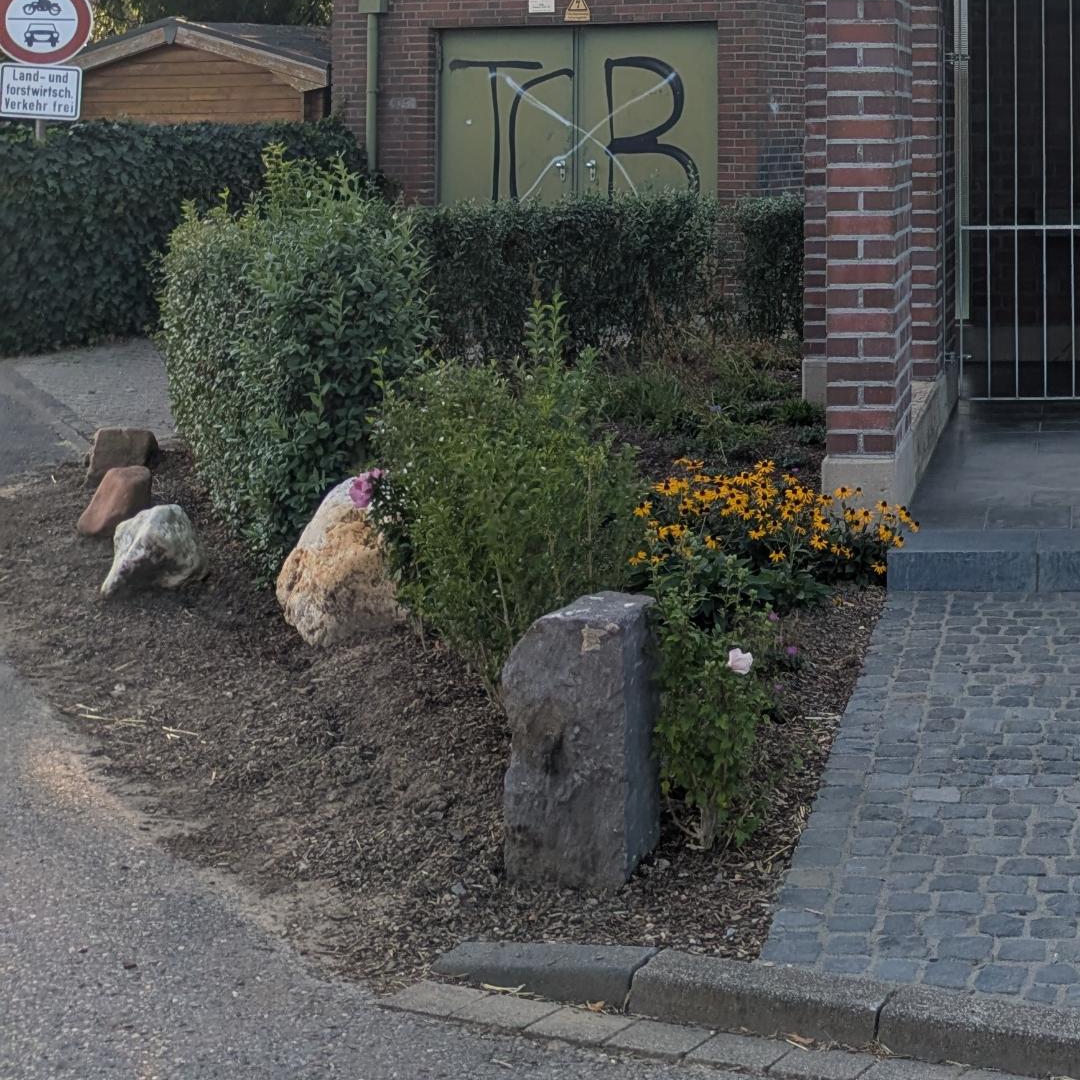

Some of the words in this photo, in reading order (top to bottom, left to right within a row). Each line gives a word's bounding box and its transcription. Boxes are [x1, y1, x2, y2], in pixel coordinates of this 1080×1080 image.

[12, 69, 46, 82] Land-
[48, 72, 69, 84] und
[6, 84, 74, 99] forstwirtsch.
[4, 98, 48, 111] Verkehr
[53, 100, 74, 113] frei
